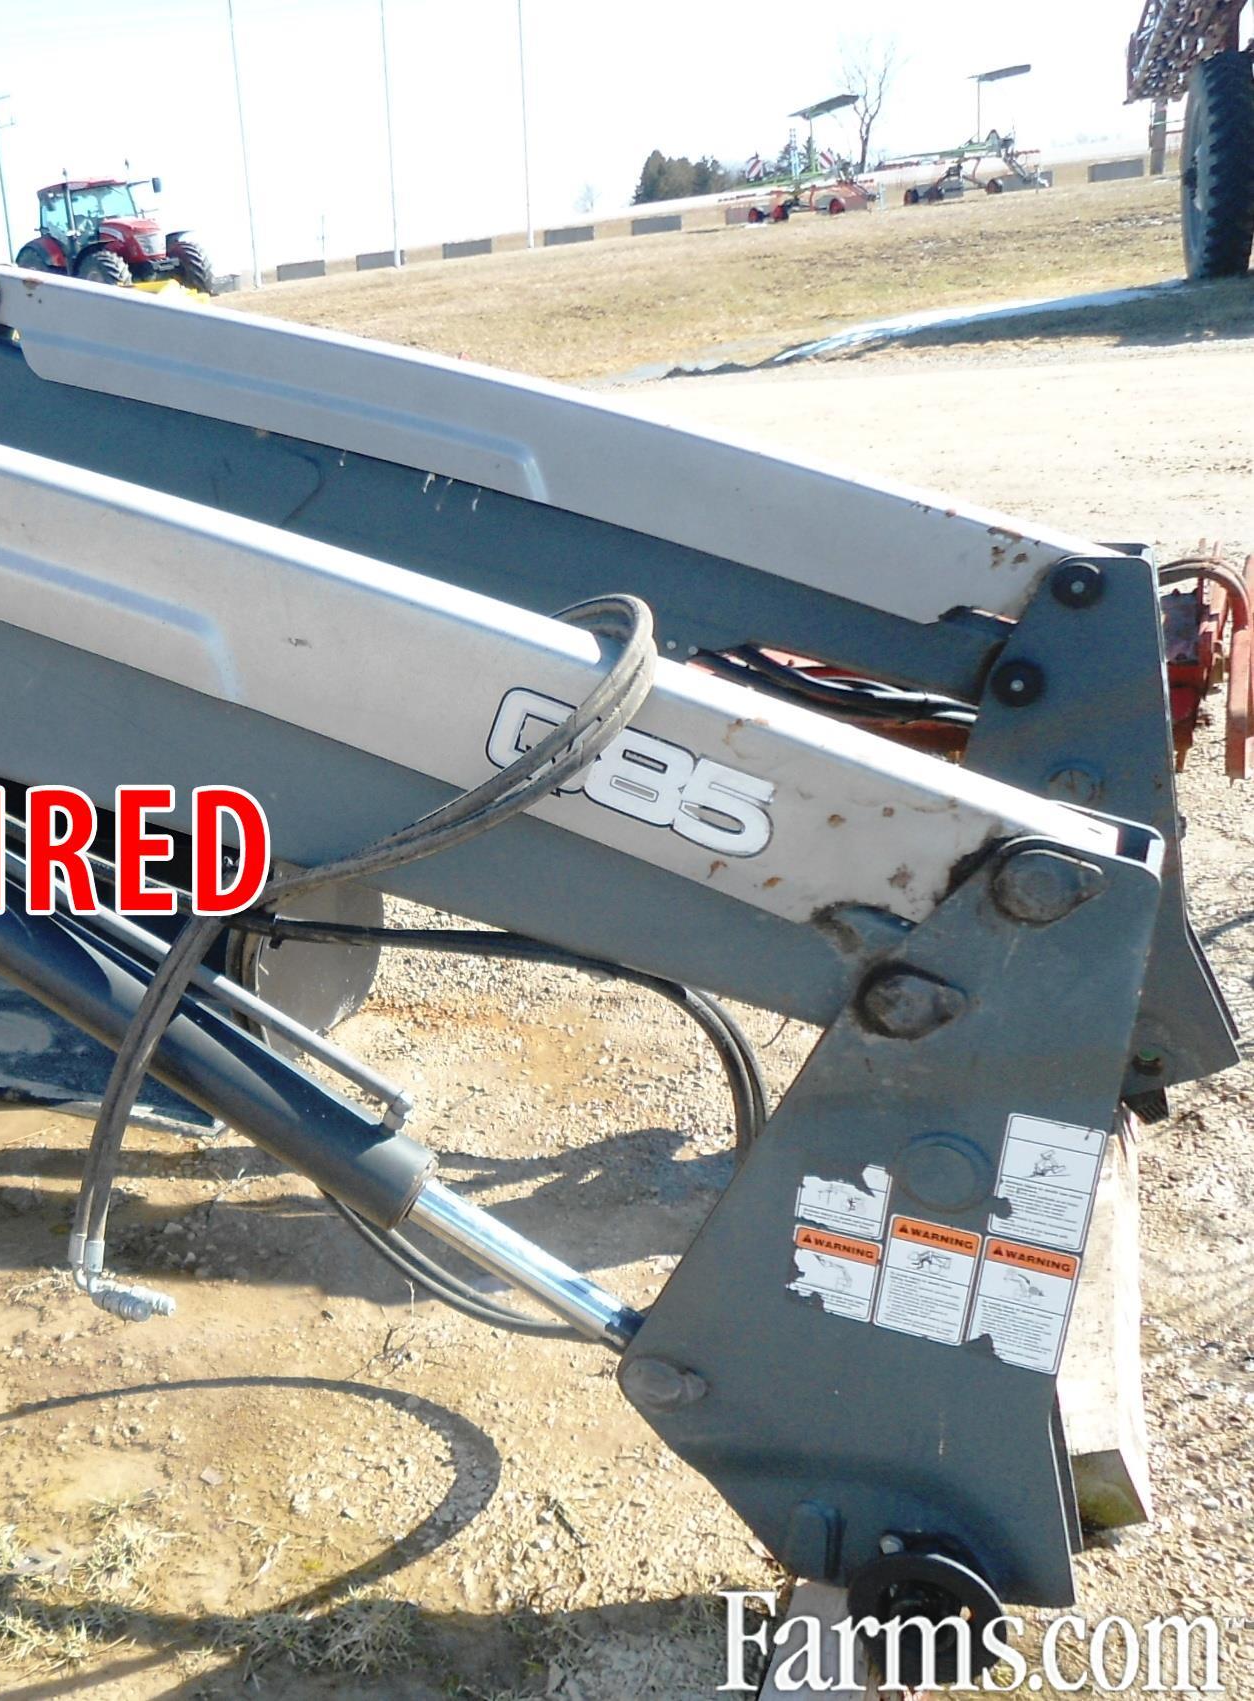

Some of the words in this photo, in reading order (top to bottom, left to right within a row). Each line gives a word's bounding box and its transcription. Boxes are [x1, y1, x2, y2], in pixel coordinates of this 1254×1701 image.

[814, 1237, 875, 1260] WARNING
[910, 1227, 974, 1250] WARNING
[1005, 1250, 1071, 1273] WARNING
